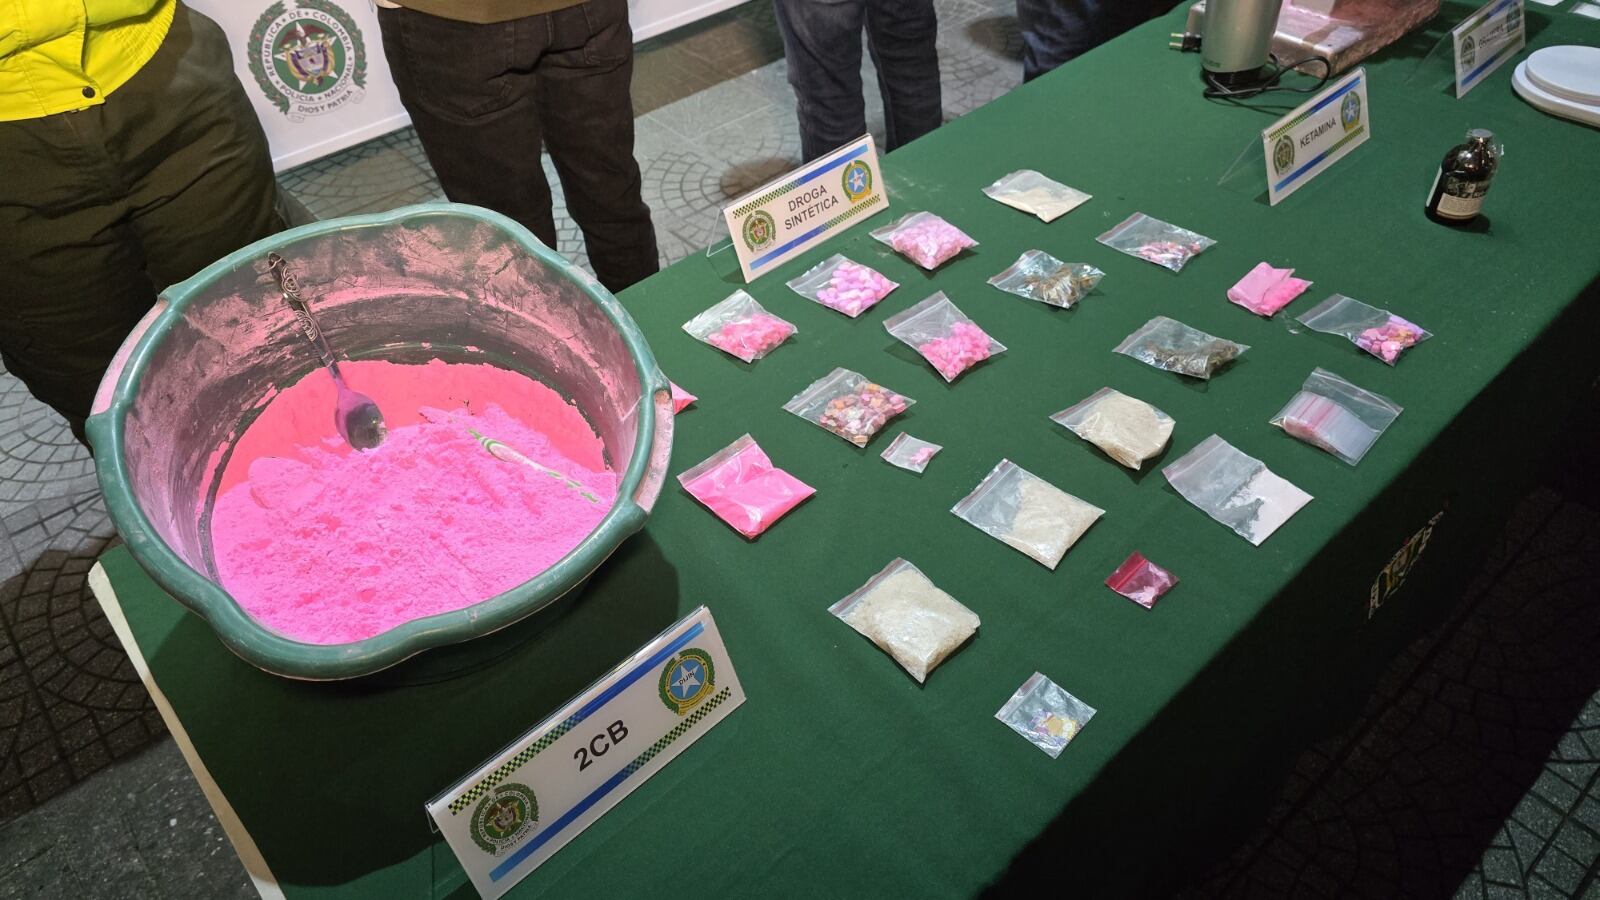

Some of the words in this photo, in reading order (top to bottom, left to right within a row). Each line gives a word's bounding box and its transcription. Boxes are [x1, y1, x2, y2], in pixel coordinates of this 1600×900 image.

[264, 22, 283, 78] REPUBLICA
[288, 10, 303, 20] DE
[312, 11, 353, 53] COLOMBIA
[280, 83, 315, 102] POLICIA
[324, 64, 353, 99] NACIONAL
[327, 90, 353, 109] PATRIA
[1299, 116, 1337, 149] KETAMINA
[784, 195, 839, 230] SINTÉTICA
[788, 184, 828, 212] DROGA
[678, 670, 695, 685] DIJIN
[573, 718, 629, 771] 2CB
